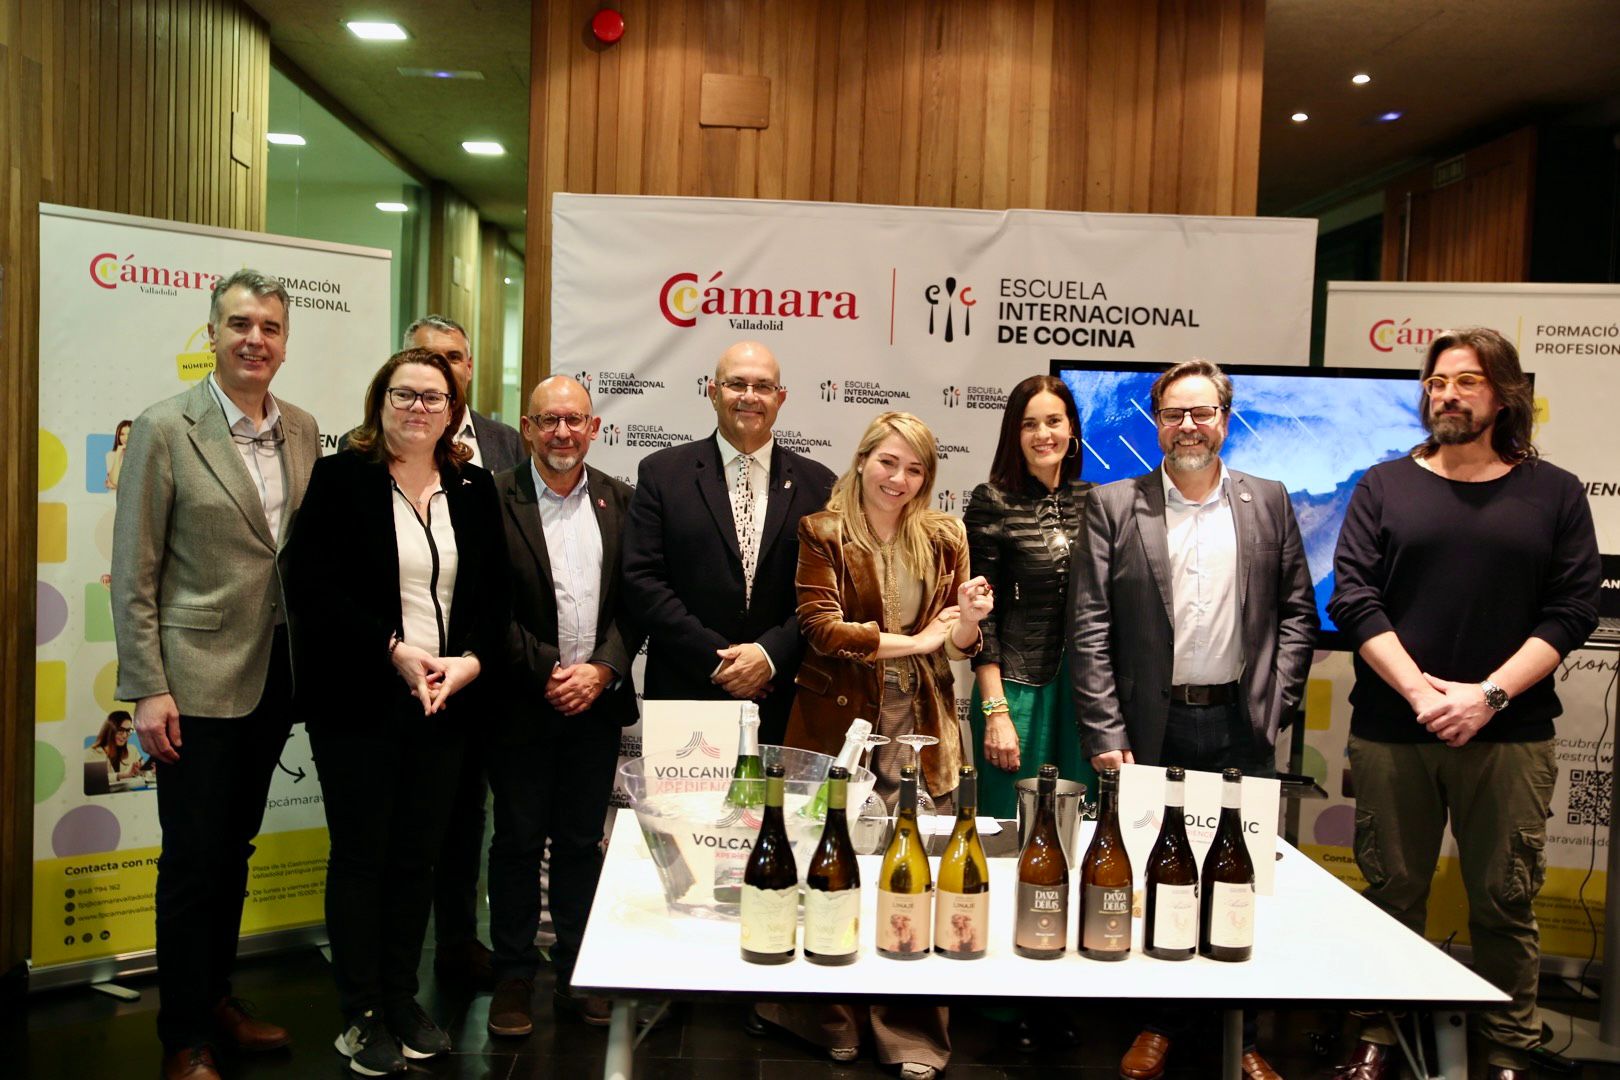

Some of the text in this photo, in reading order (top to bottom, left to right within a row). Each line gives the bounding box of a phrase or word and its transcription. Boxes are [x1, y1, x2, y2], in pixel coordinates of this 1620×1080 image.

[140, 285, 177, 296] Valladolid
[278, 277, 341, 294] RMACIÓN
[1000, 278, 1108, 300] ESCUELA
[287, 295, 351, 313] FESIONAL
[659, 270, 860, 327] Cámara
[998, 301, 1200, 328] INTERNACIONAL
[729, 319, 784, 332] Valladolid
[1536, 323, 1620, 338] FORMACIÓ
[998, 325, 1136, 348] DE COCINA
[1535, 343, 1620, 355] PROFESION
[599, 371, 636, 380] ESCUELA
[599, 379, 665, 389] INTERNACIONAL
[845, 381, 880, 389] ESCUELA
[610, 387, 644, 395] COCINA
[844, 388, 911, 399] INTERNACIONAL
[967, 386, 1003, 395] ESCUELA
[856, 397, 889, 405] COCINA
[627, 424, 664, 432] ESCUELA
[627, 432, 694, 441] INTERNACIONAL
[638, 440, 672, 448] COCINA
[693, 833, 753, 850] VOLCA
[64, 862, 119, 876] Contacta
[122, 859, 143, 868] con
